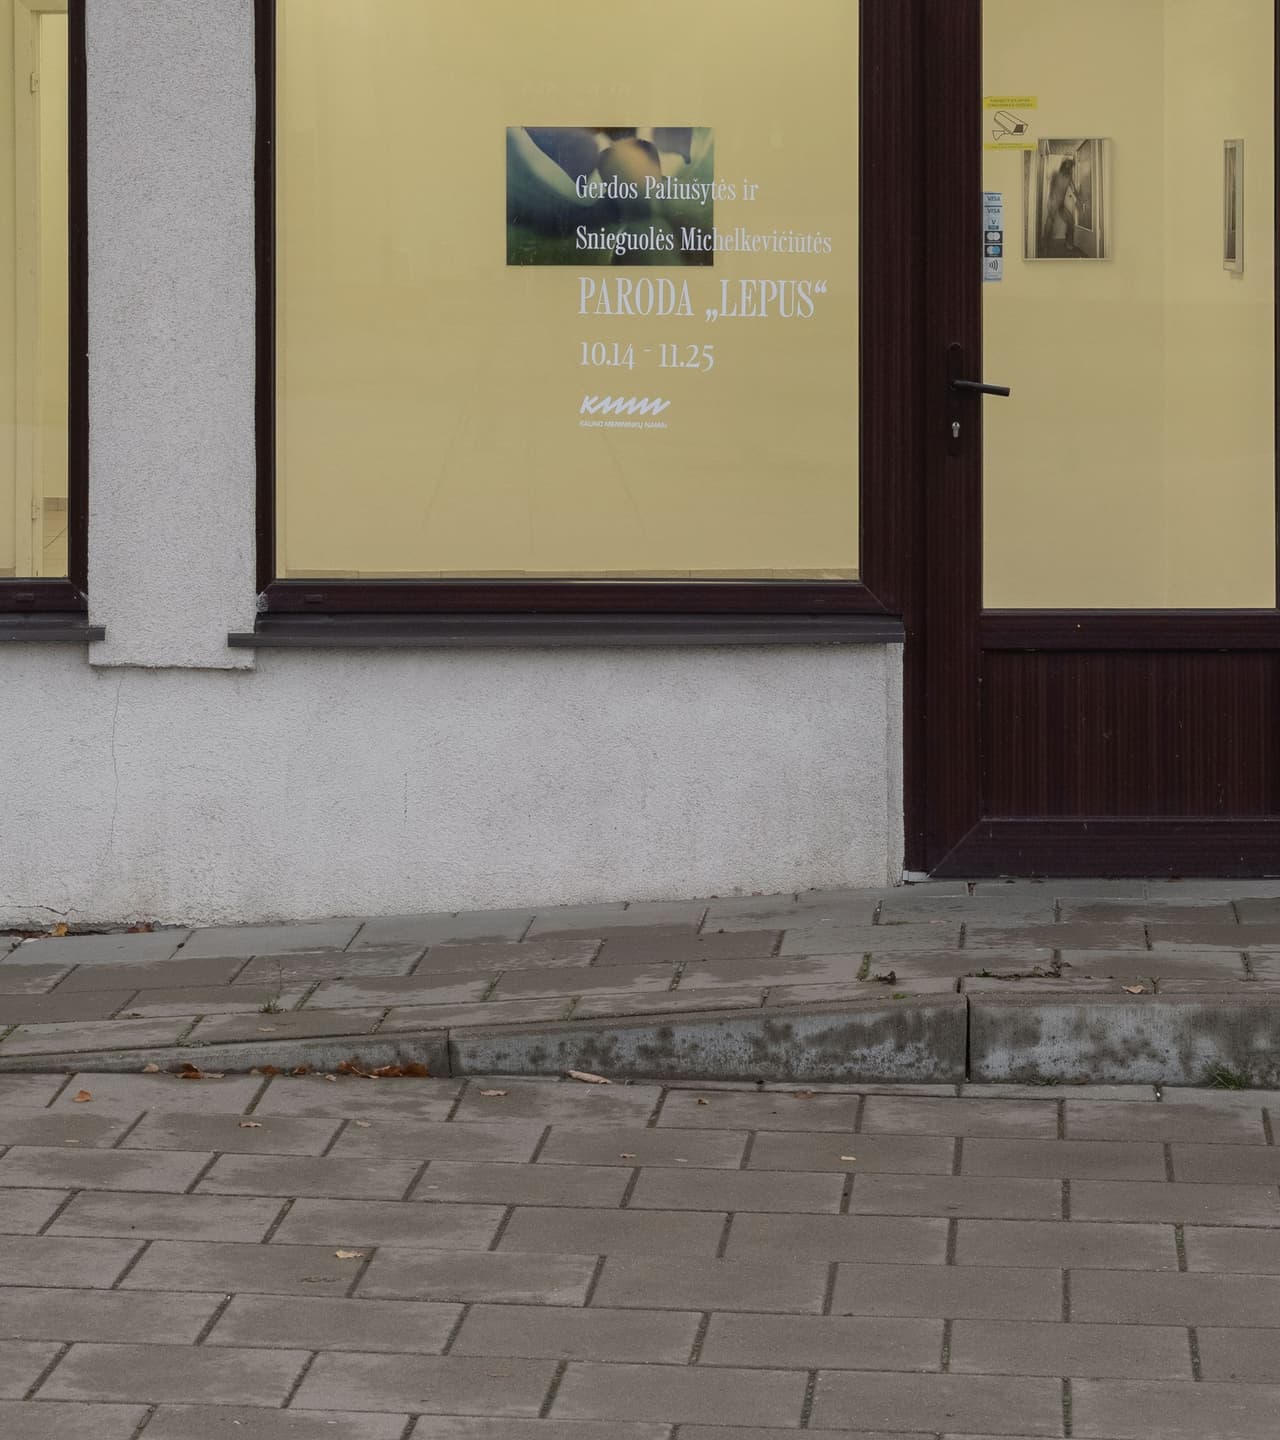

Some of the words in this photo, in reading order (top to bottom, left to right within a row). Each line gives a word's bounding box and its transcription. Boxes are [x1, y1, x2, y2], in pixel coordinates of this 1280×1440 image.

[575, 174, 638, 199] Gerdos
[644, 175, 736, 205] Paliušytės
[743, 178, 759, 200] ir
[575, 225, 674, 255] Snieguolės
[577, 276, 695, 316] PARODA
[705, 278, 828, 323] „LEPUS“
[580, 342, 635, 370] 10.14
[658, 343, 714, 372] 11.25
